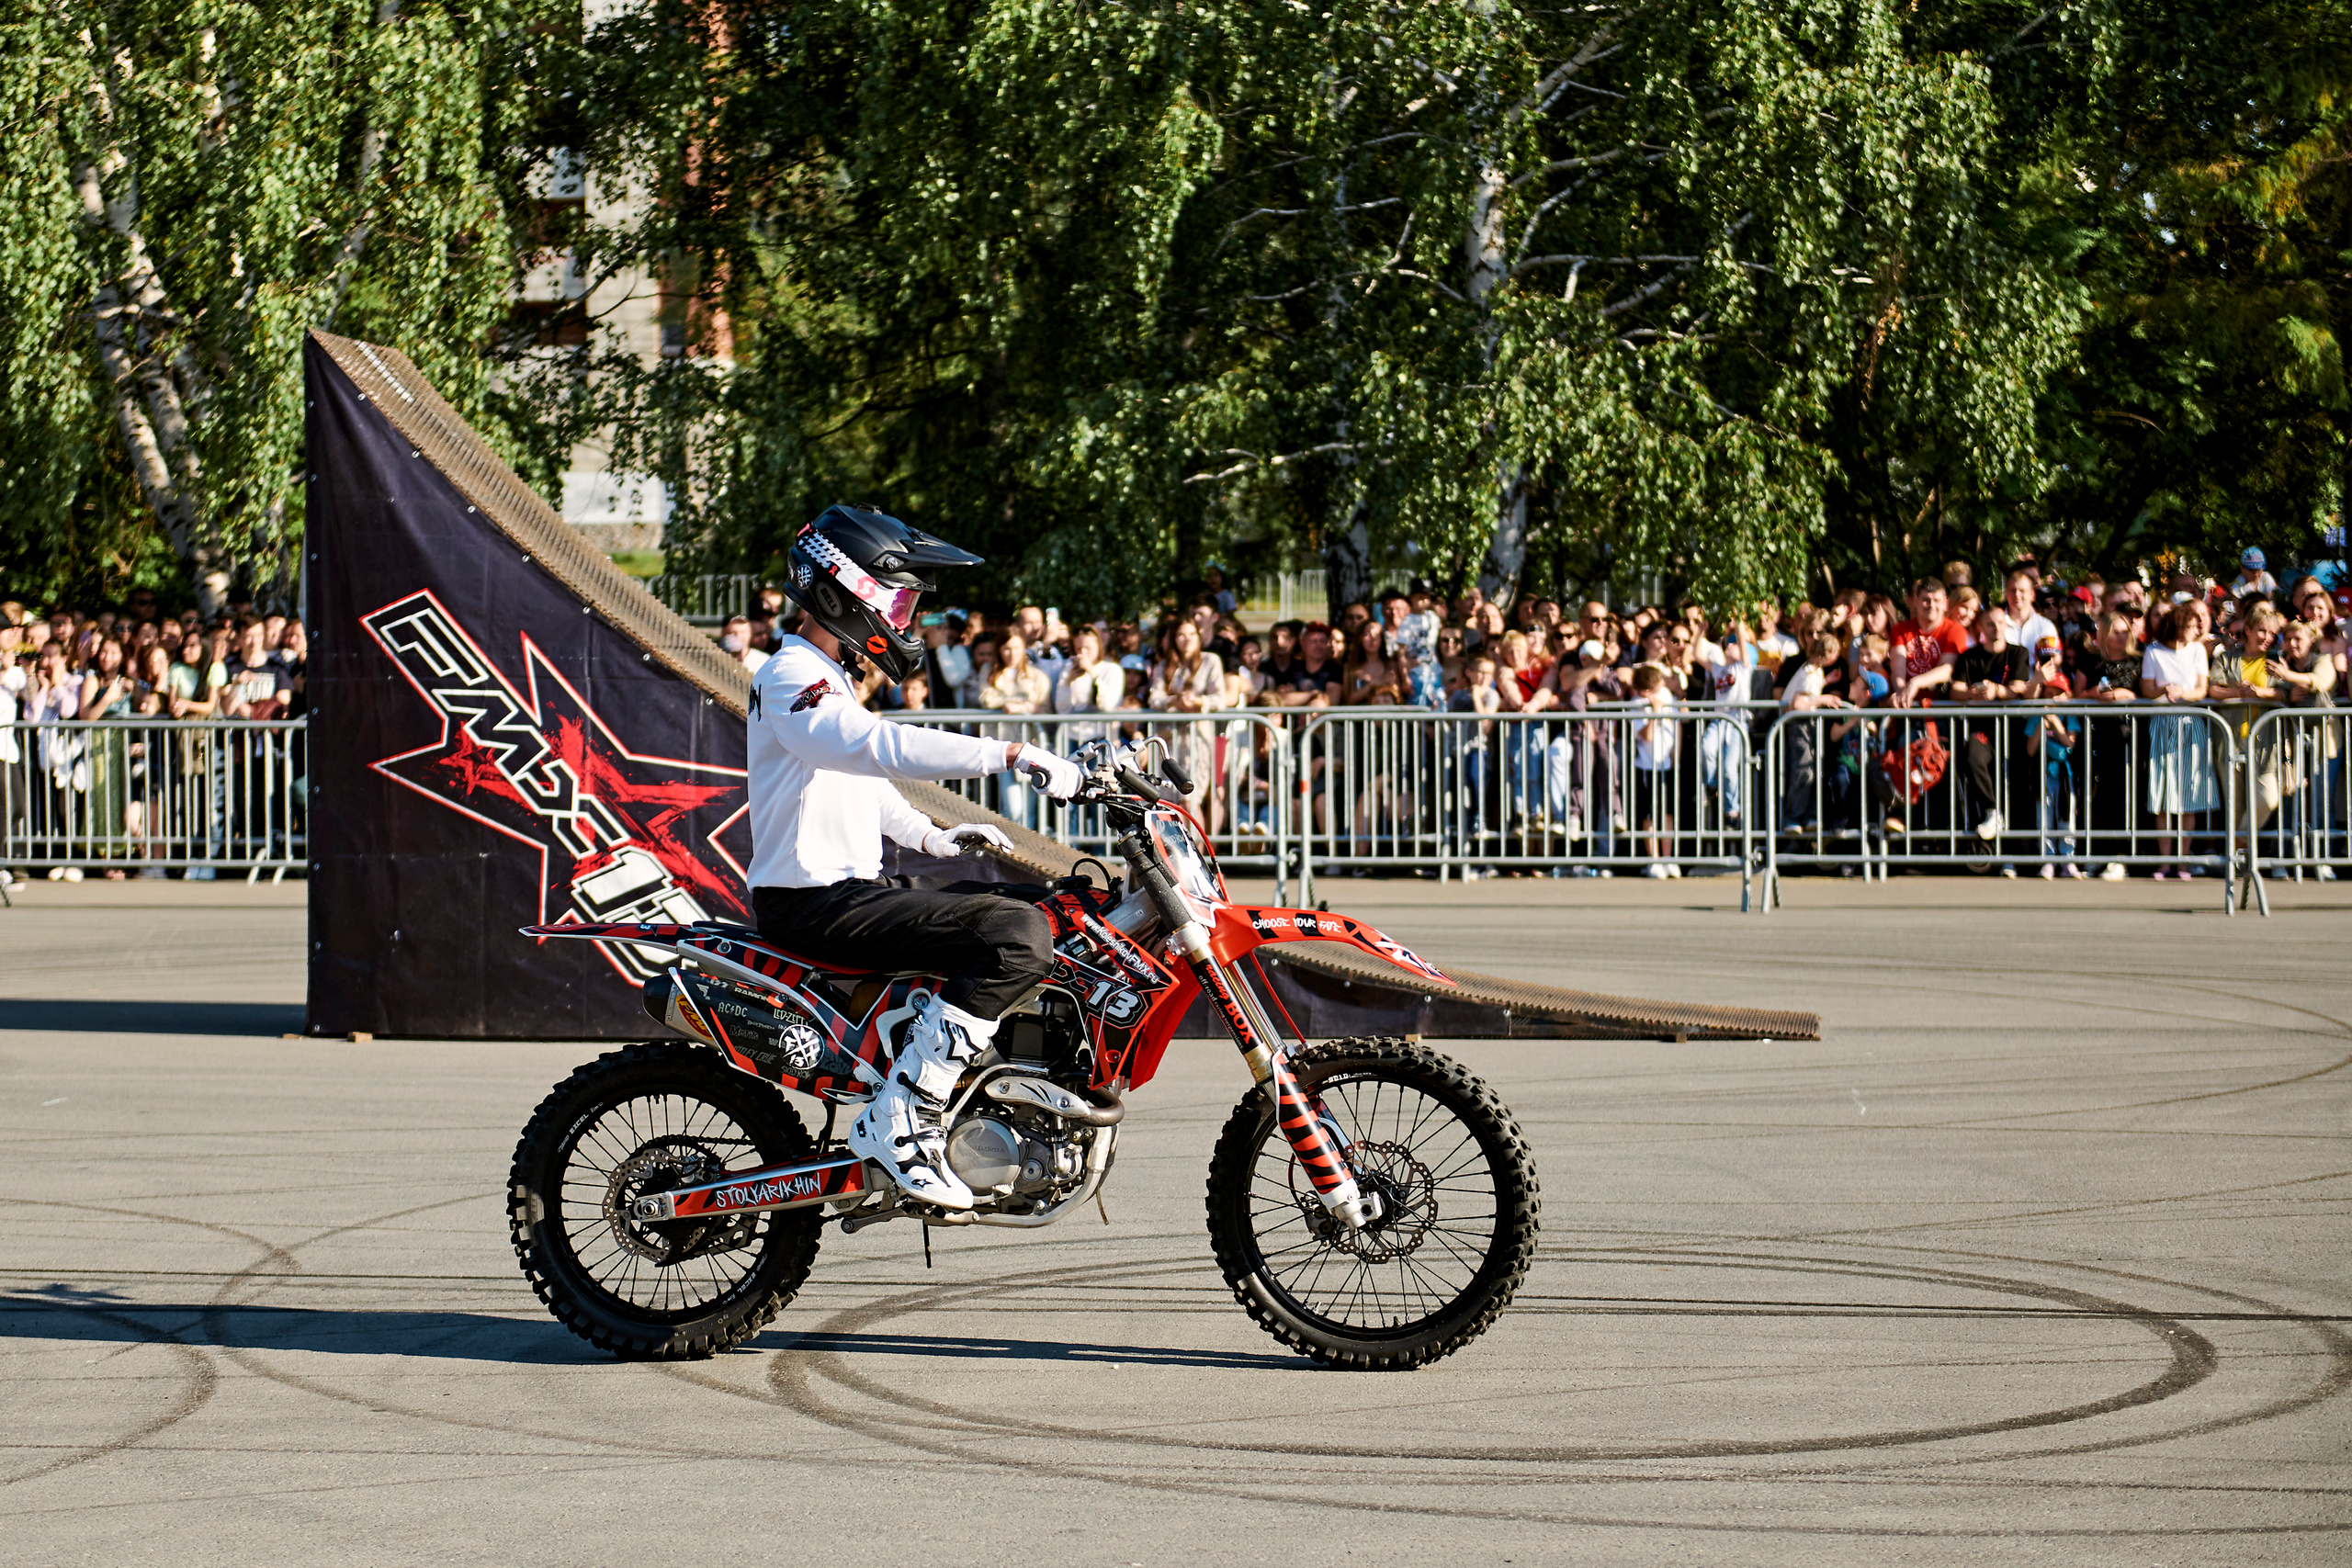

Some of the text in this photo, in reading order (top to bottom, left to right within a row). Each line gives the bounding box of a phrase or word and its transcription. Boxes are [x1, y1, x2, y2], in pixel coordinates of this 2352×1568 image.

[820, 587, 838, 613] BELL
[1252, 918, 1290, 930] CHOOSE
[1293, 917, 1317, 928] YOUR
[1080, 912, 1160, 985] www.KolesnikovFMX.ru
[734, 986, 768, 1002] RAMON
[1087, 980, 1140, 1020] 13
[1205, 964, 1259, 1044] racing BOX
[716, 1171, 821, 1208] STOLYARIKHIN
